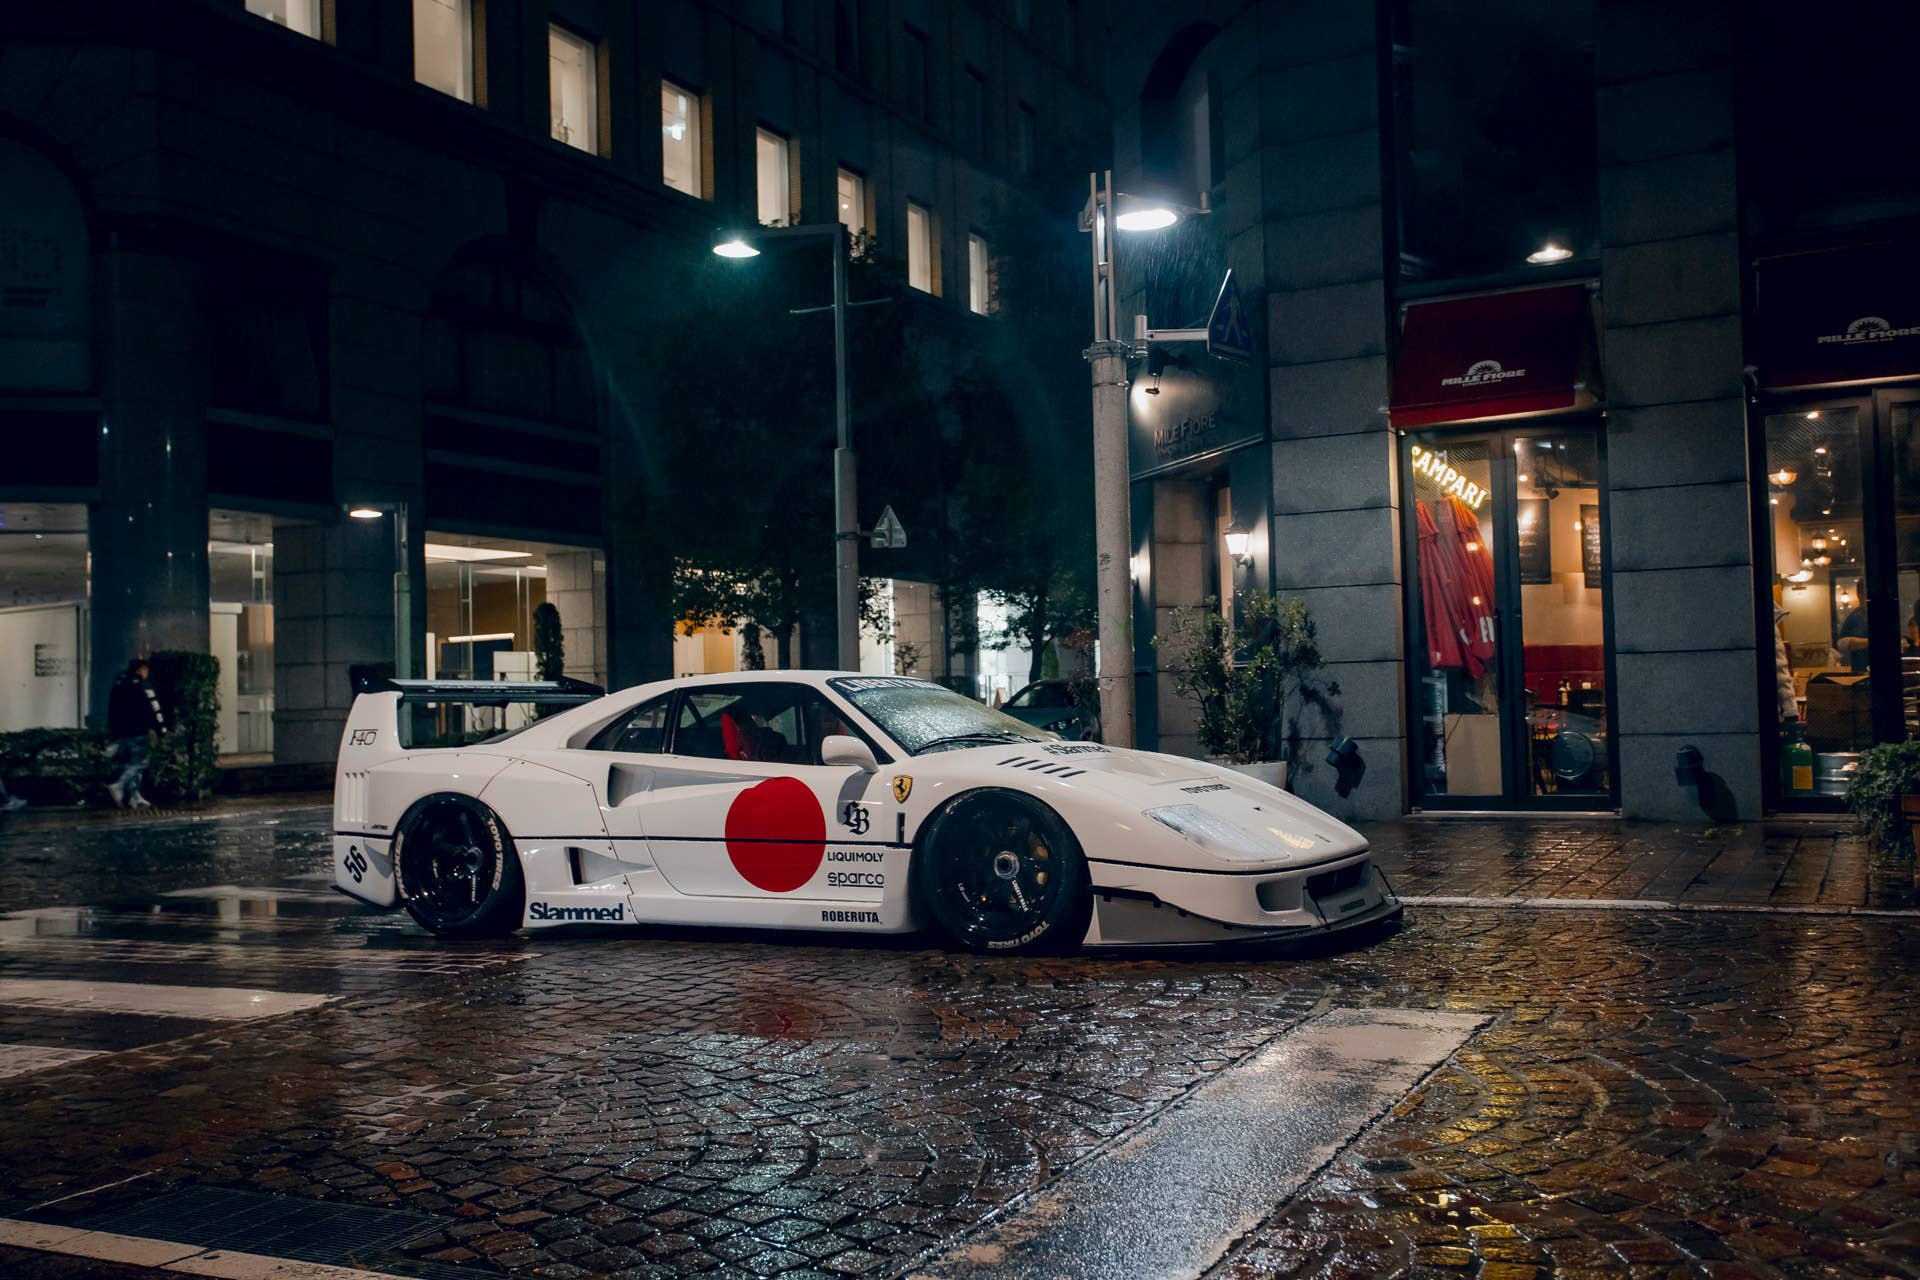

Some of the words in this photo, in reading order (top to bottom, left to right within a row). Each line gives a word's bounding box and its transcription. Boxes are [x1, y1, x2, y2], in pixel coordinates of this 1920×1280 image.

[1817, 332, 1865, 343] MILLE
[1441, 374, 1481, 386] MILLE
[1483, 369, 1527, 381] FIORE
[349, 729, 378, 746] F40
[343, 845, 368, 883] 56
[827, 872, 885, 888] sparco
[529, 902, 624, 921] Slammed
[821, 911, 880, 923] ROBERUTA
